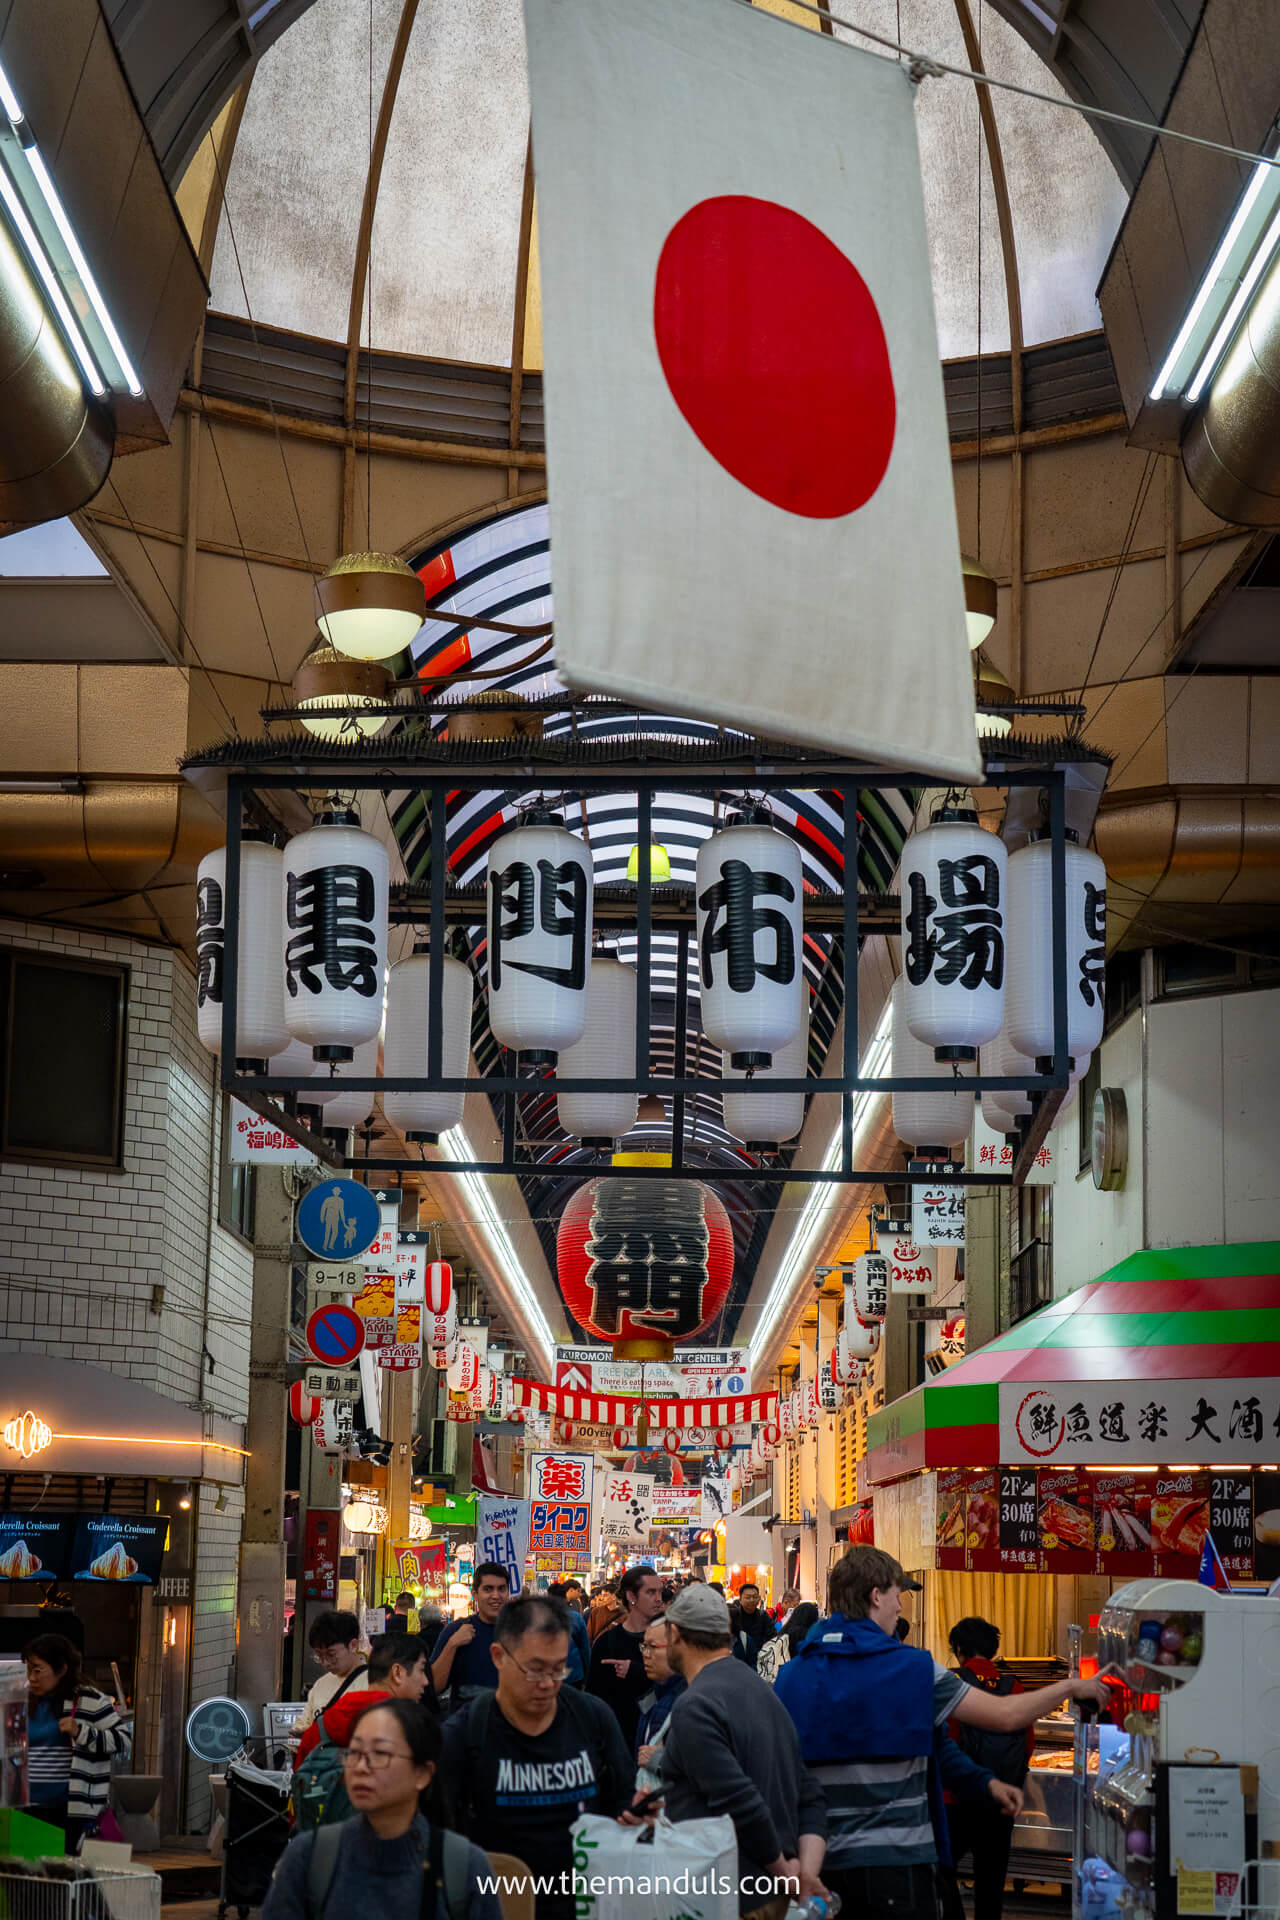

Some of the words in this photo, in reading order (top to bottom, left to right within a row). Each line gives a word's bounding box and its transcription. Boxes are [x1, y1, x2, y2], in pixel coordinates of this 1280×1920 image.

[490, 858, 588, 991] 門
[698, 859, 796, 993] 市
[905, 854, 1005, 990] 場
[979, 1144, 1053, 1168] 鮮魚楽
[865, 1258, 887, 1317] 黒門市場
[380, 1349, 419, 1357] STAMP
[562, 1350, 612, 1361] KUROMON
[687, 1354, 721, 1363] CENTER
[598, 1367, 621, 1377] FREE
[623, 1368, 643, 1377] RES
[308, 1374, 359, 1392] 自動車
[599, 1377, 621, 1385] There
[621, 1377, 628, 1386] is
[629, 1378, 652, 1387] eatng
[653, 1379, 674, 1390] space
[1185, 1397, 1280, 1443] 大酒
[576, 1426, 594, 1437] 00
[538, 1456, 585, 1499] 薬
[1001, 1476, 1021, 1497] 2F
[610, 1479, 634, 1502] 活
[1211, 1479, 1235, 1500] 2F
[533, 1505, 588, 1532] ダイコク
[1001, 1502, 1035, 1523] 30席
[1212, 1507, 1250, 1529] 30席
[25, 1521, 61, 1531] Croissant
[87, 1521, 123, 1533] Cinderella
[123, 1524, 157, 1535] Croissant
[483, 1531, 517, 1564] SEA
[153, 1577, 190, 1598] FFEE
[495, 1749, 596, 1794] MINNESOTA
